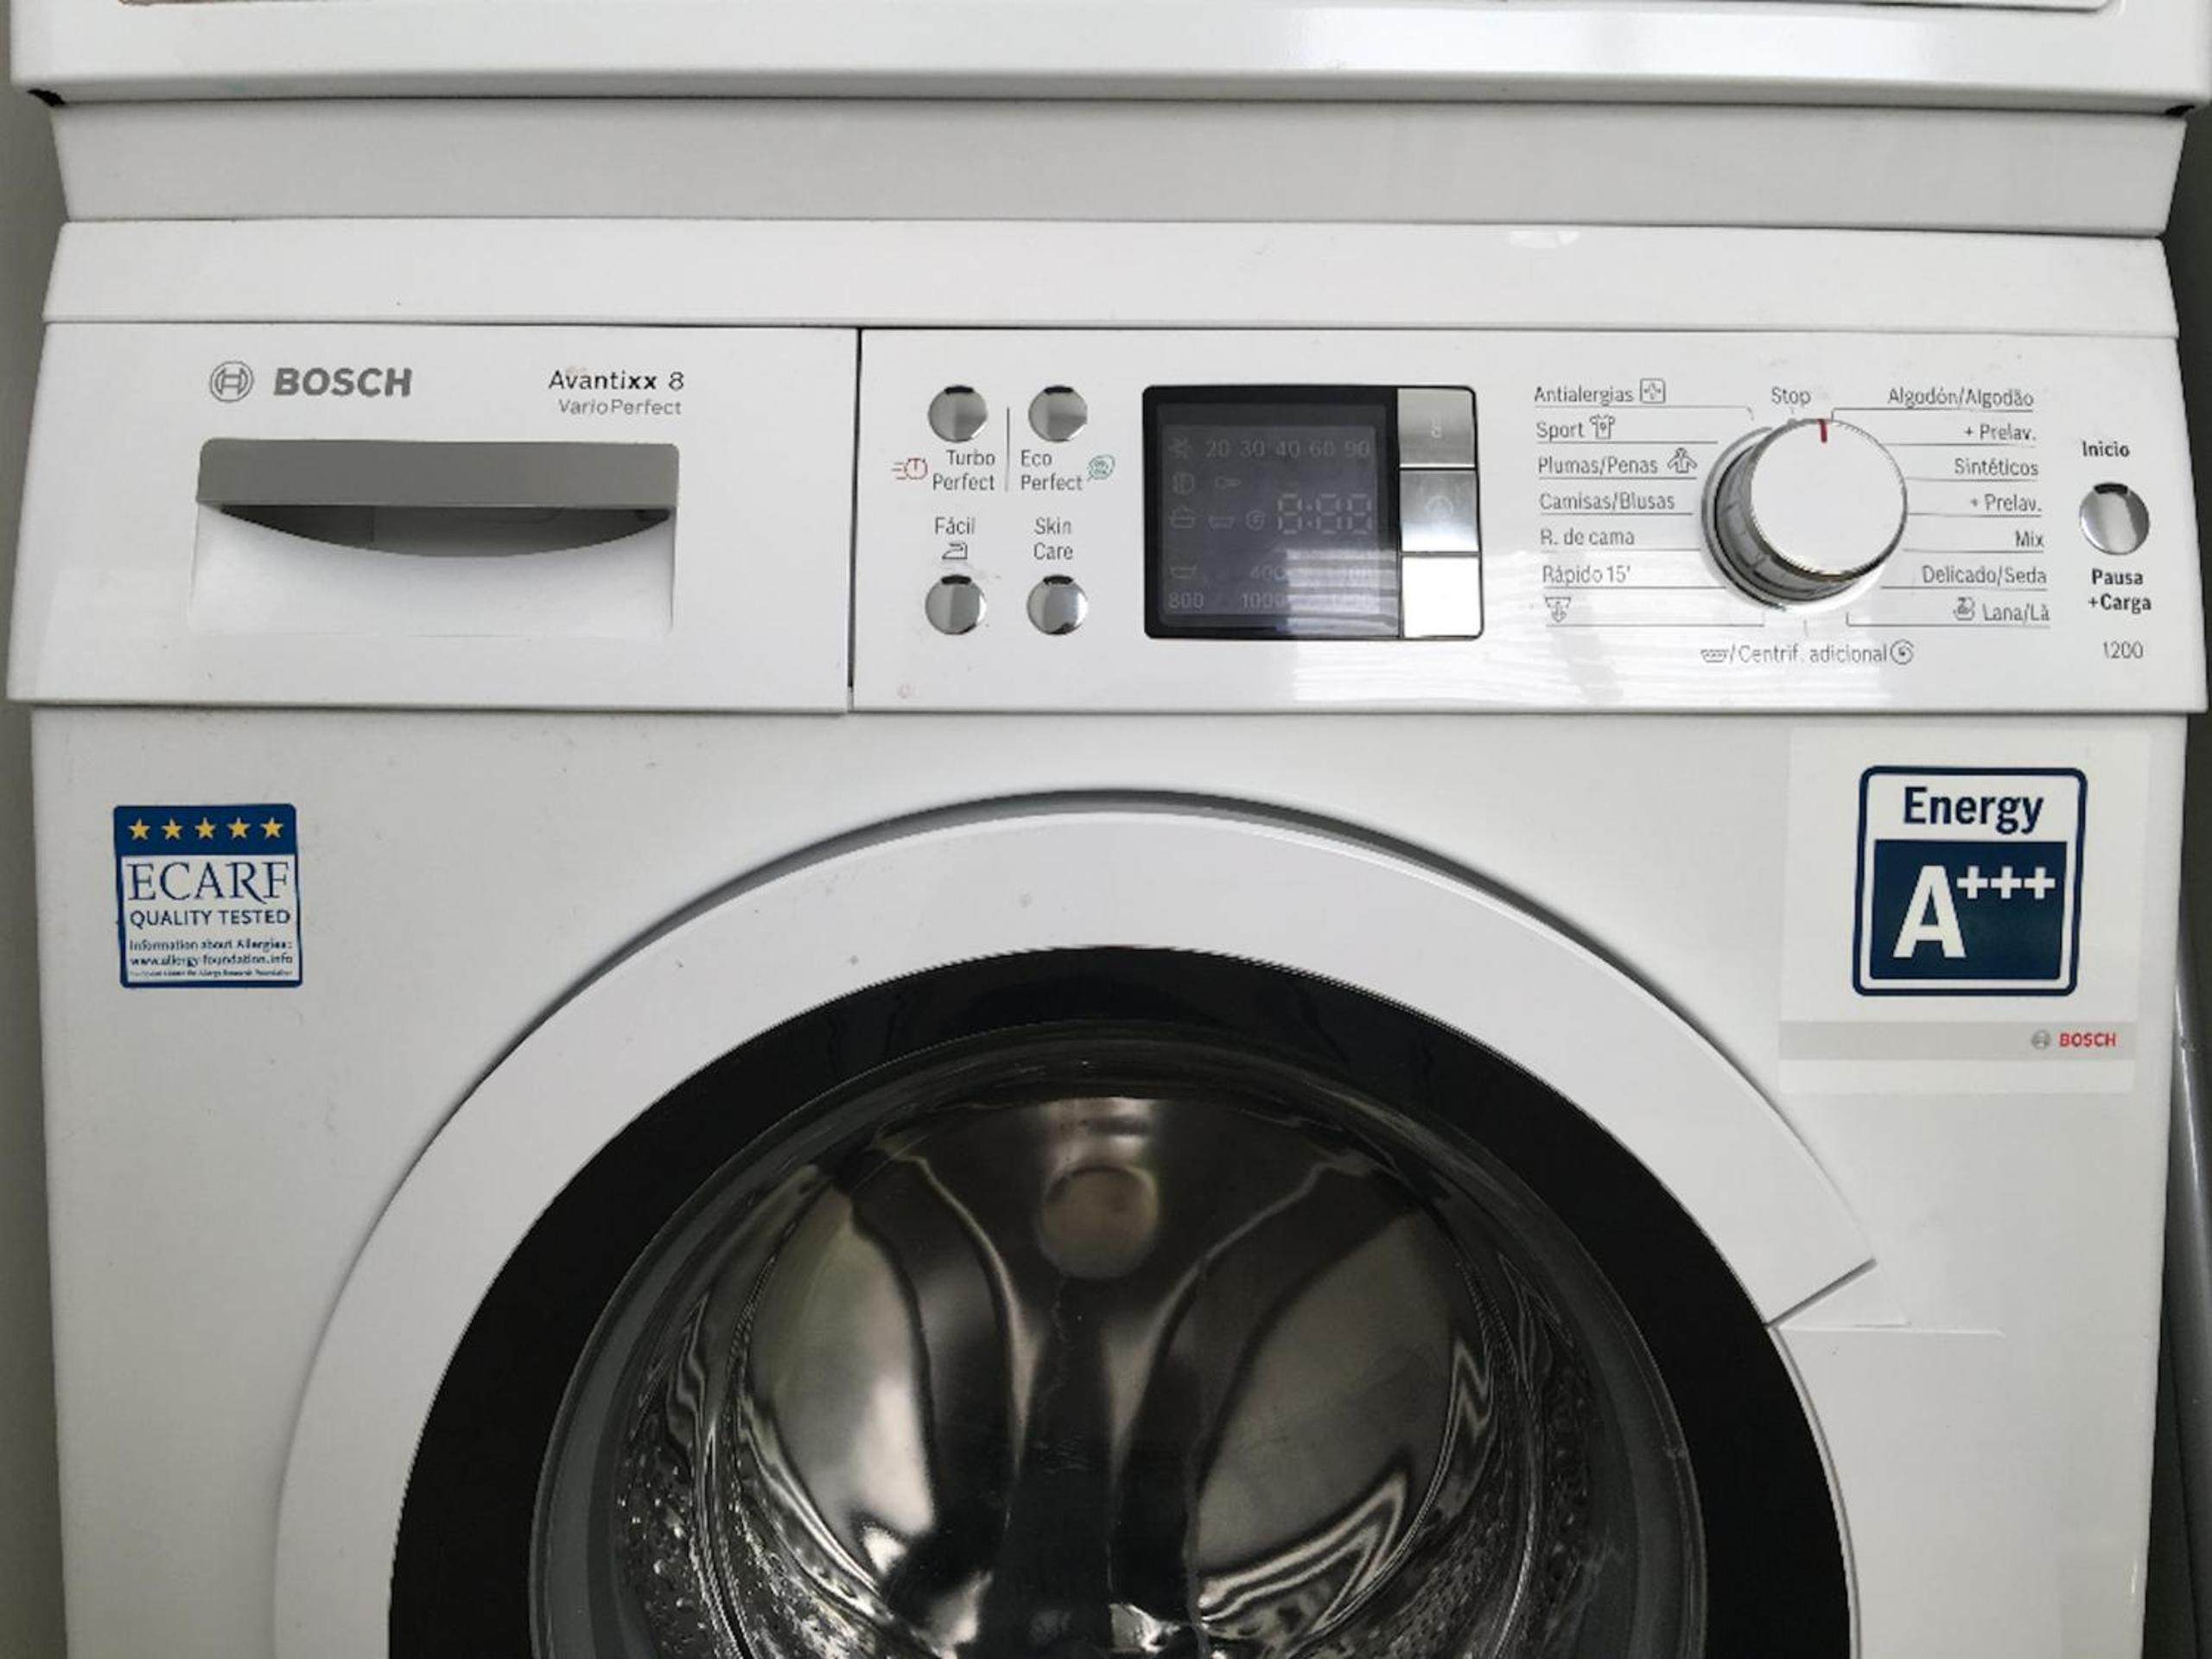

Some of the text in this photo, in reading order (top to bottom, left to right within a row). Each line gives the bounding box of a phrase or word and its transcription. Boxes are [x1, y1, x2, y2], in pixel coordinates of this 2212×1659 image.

[273, 367, 412, 397] BOSCH
[548, 369, 684, 391] Avantixx 8
[1535, 385, 1634, 407] Antialergias
[1771, 385, 1812, 407] Stop
[1888, 387, 2033, 409] Algodón/Algodão
[558, 398, 682, 416] VarioPerfect
[1536, 421, 1585, 442] Sport
[1980, 423, 2037, 441] Prelav.
[947, 449, 995, 467] Turbo
[1020, 449, 1052, 467] Eco
[1204, 438, 1231, 459] 20
[1238, 438, 1266, 459] 30
[1538, 455, 1658, 475] Plumas/Penas
[1954, 457, 2039, 476] Sintéticos
[932, 474, 995, 492] Perfect
[1020, 474, 1083, 492] Perfect
[1539, 492, 1675, 511] Camisas/Blusas
[1985, 493, 2043, 512] Prelav.
[934, 516, 976, 535] Fácil
[1033, 517, 1072, 535] Skin
[1540, 527, 1635, 545] R. de cama
[2015, 530, 2045, 547] Mix
[1033, 542, 1073, 561] Care
[1542, 565, 1603, 586] Rápido
[1922, 564, 2047, 586] Delicado/Seda
[2092, 568, 2143, 585] Pausa
[2088, 593, 2152, 614] +Carga
[1809, 644, 1887, 663] adicional
[2103, 640, 2144, 659] 1200
[1904, 785, 2044, 836] Energy
[126, 861, 289, 905] ECARF
[130, 909, 291, 930] QUALITY TESTED
[1892, 864, 2056, 959] A+++
[129, 938, 198, 951] Information
[2059, 1032, 2117, 1048] BOSCH
